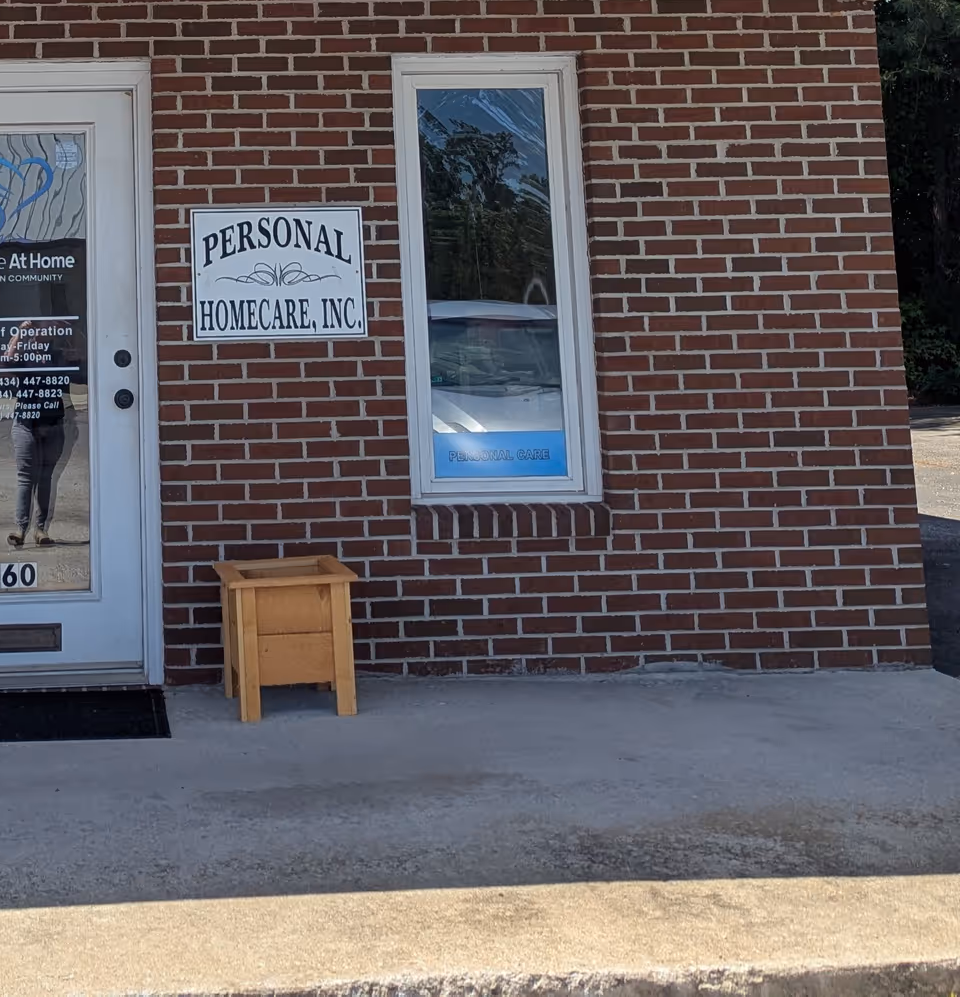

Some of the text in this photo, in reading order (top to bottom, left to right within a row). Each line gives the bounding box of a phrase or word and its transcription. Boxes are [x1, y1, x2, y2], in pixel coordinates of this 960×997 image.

[202, 216, 352, 268] PERSONAL
[9, 253, 28, 269] At
[30, 253, 75, 268] Home
[8, 274, 63, 282] COMMUNITY
[200, 297, 362, 332] HOMECARE, INC.
[10, 326, 72, 338] Operation
[23, 376, 70, 385] 447-8820
[16, 389, 62, 398] 447-8823
[15, 402, 41, 410] Please
[44, 401, 59, 409] Call
[5, 412, 40, 420] 447-8820
[449, 449, 549, 462] PERSONAL CARE
